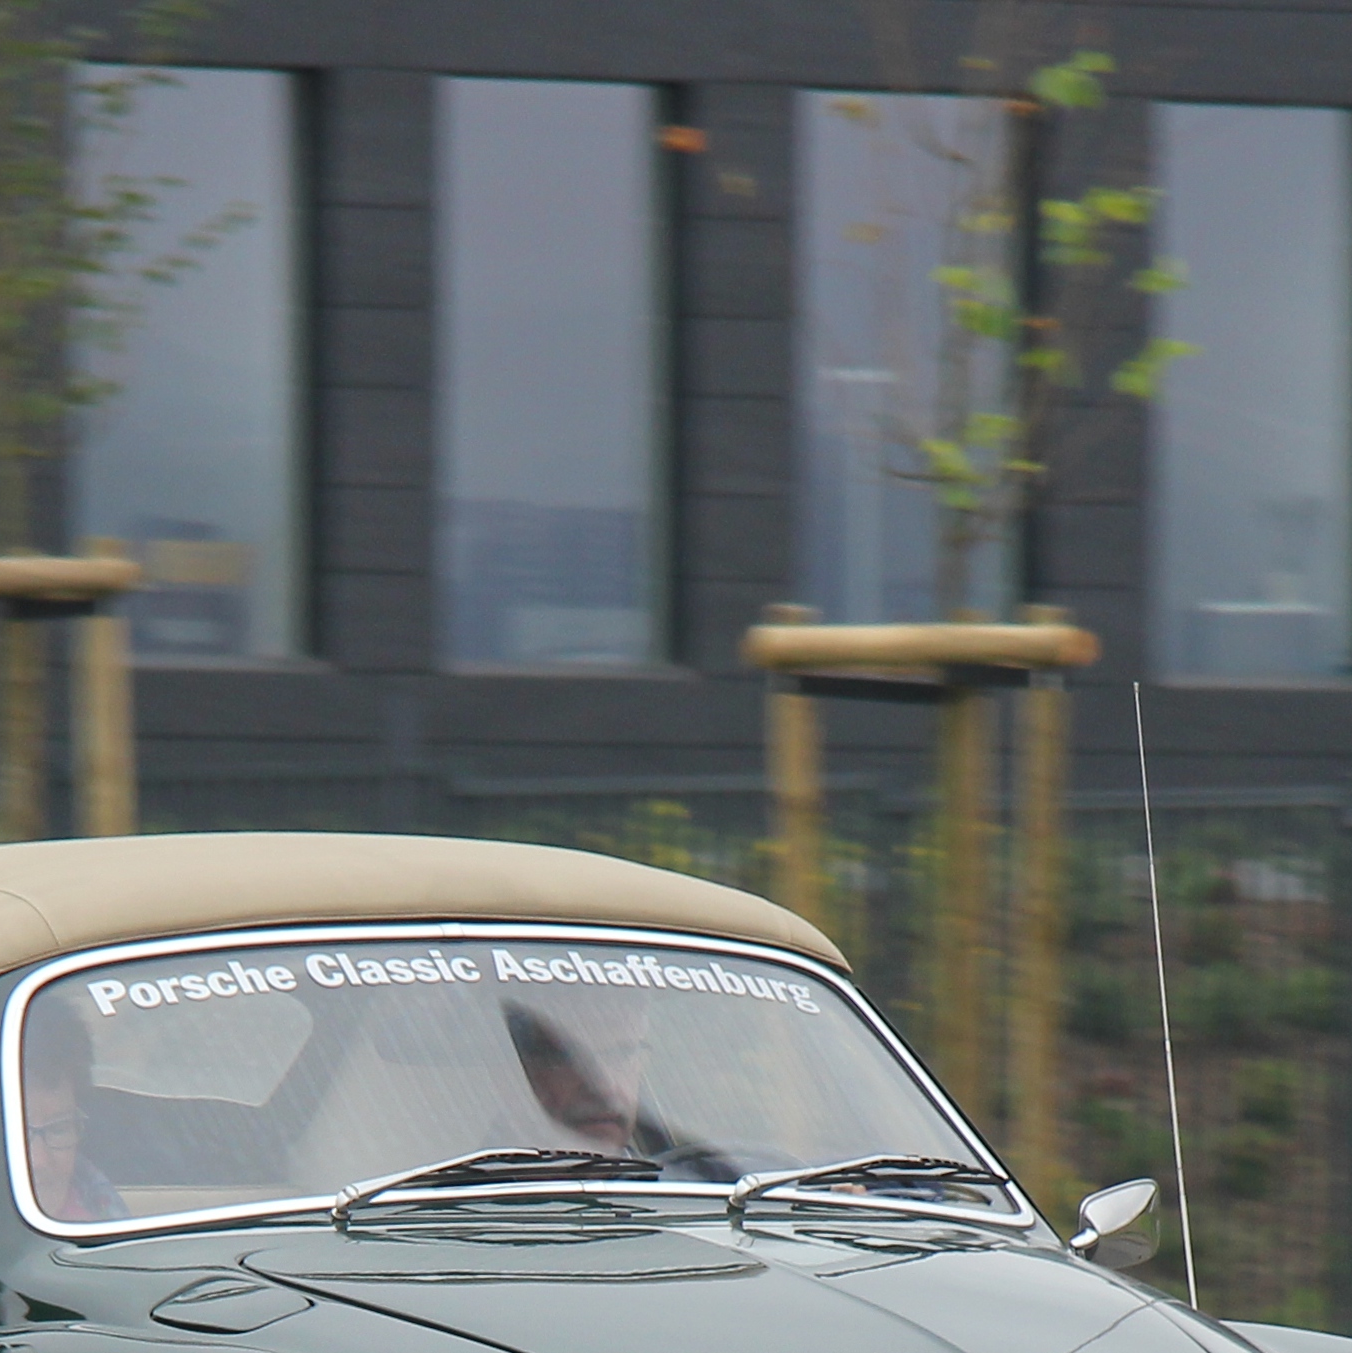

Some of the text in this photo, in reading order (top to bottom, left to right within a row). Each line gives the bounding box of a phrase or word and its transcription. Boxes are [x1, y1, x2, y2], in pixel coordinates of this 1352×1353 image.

[87, 949, 822, 1017] Porsche Classic Aschaffenburg
